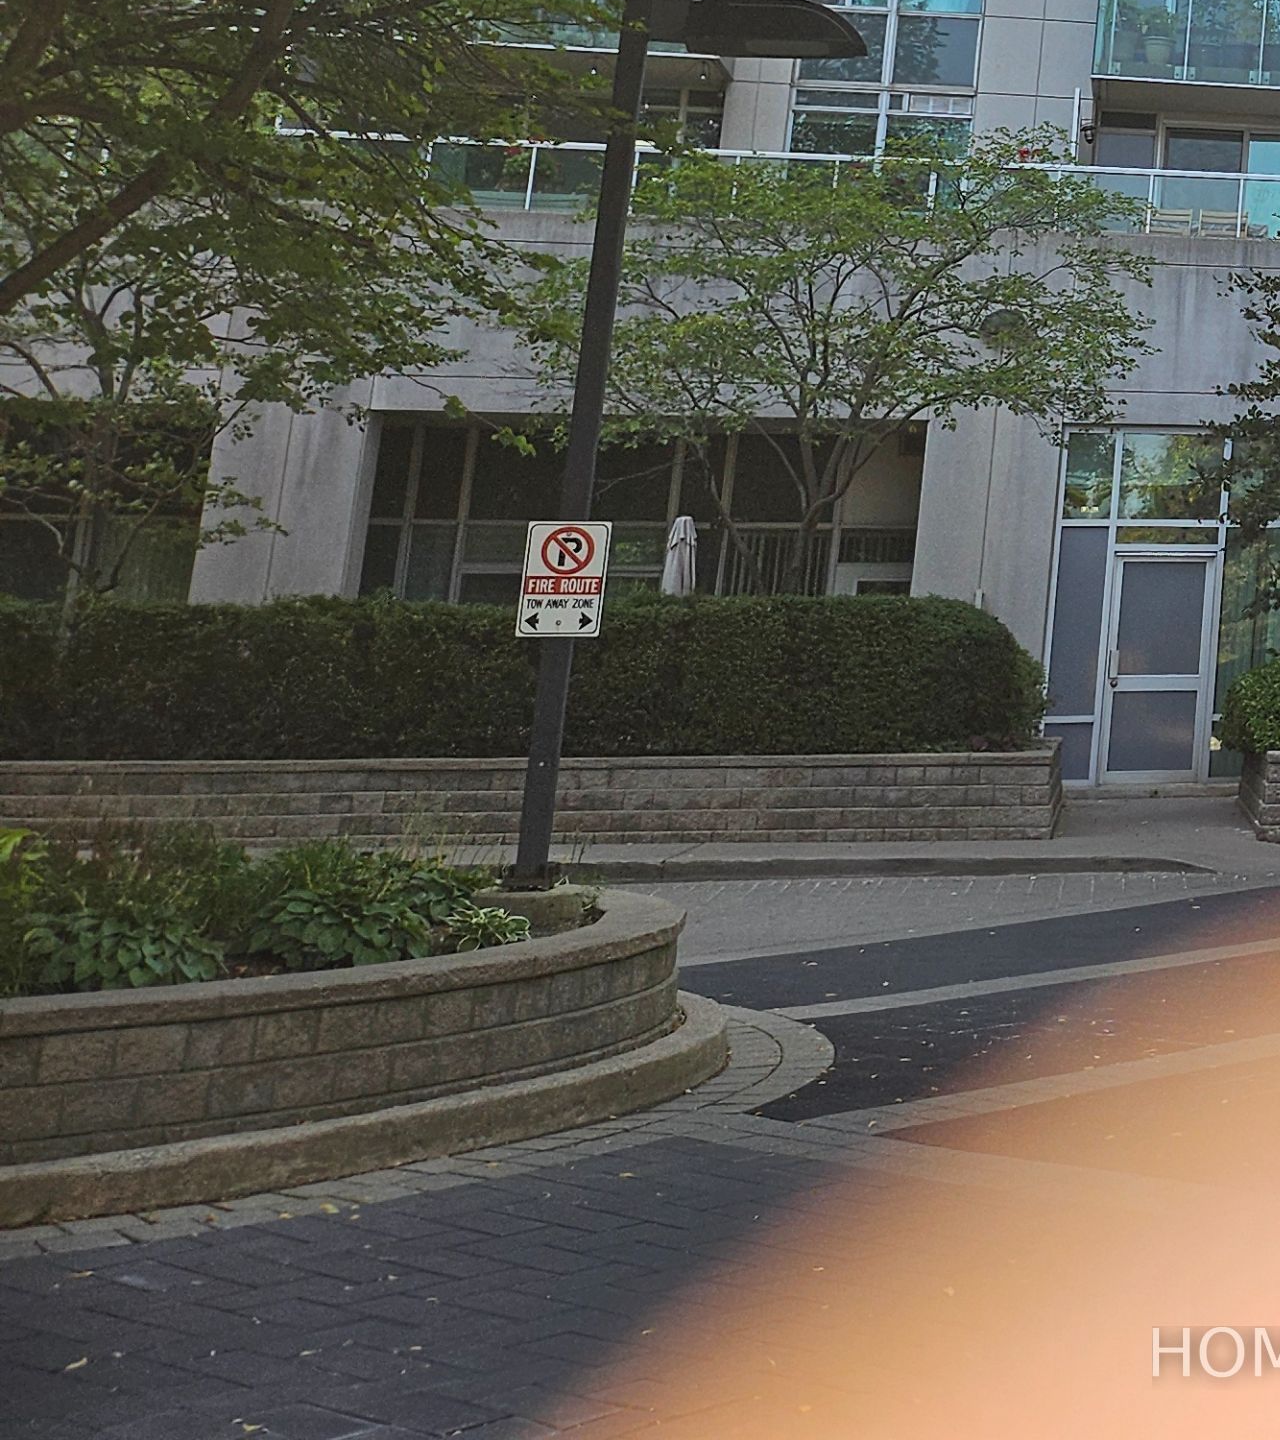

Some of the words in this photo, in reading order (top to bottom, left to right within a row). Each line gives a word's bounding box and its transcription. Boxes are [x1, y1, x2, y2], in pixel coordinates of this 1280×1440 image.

[527, 578, 555, 593] FIRE
[560, 578, 600, 593] ROUTE
[526, 599, 544, 609] TOW
[545, 599, 569, 609] AWAY
[572, 599, 595, 609] ZONE
